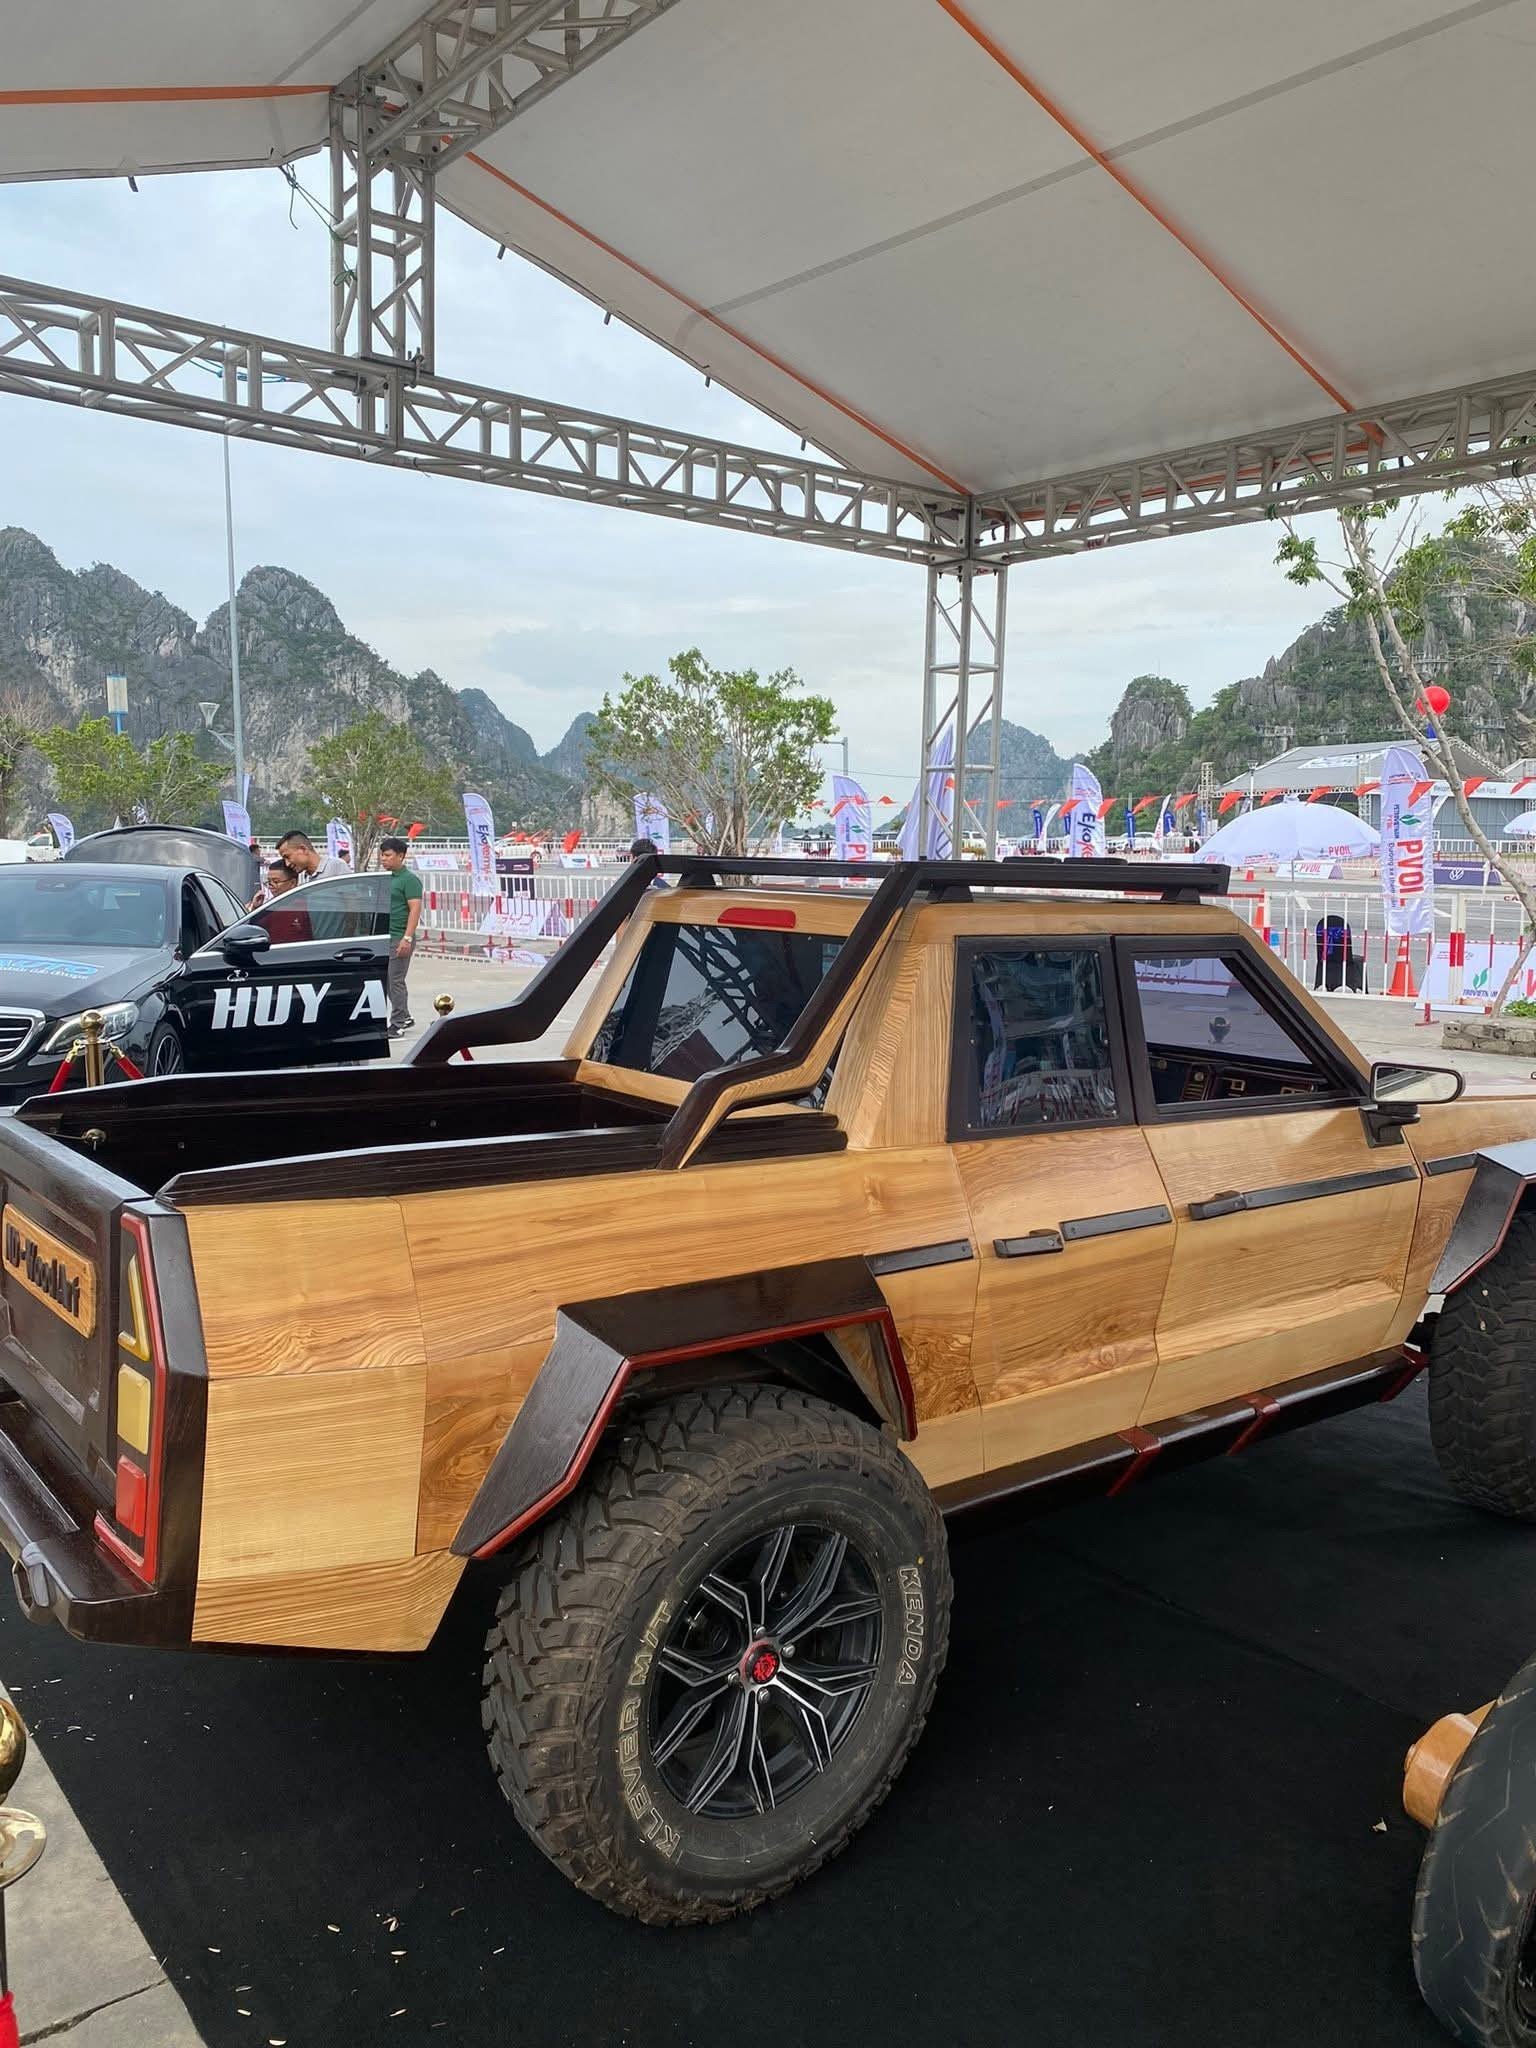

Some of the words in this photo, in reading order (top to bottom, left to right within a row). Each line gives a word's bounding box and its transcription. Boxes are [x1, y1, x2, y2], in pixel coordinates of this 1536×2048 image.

[1396, 839, 1424, 907] PVOI
[211, 982, 332, 1030] HUY
[349, 979, 388, 1020] A
[899, 1567, 924, 1685] KENDA
[619, 1696, 681, 1858] KLEVER
